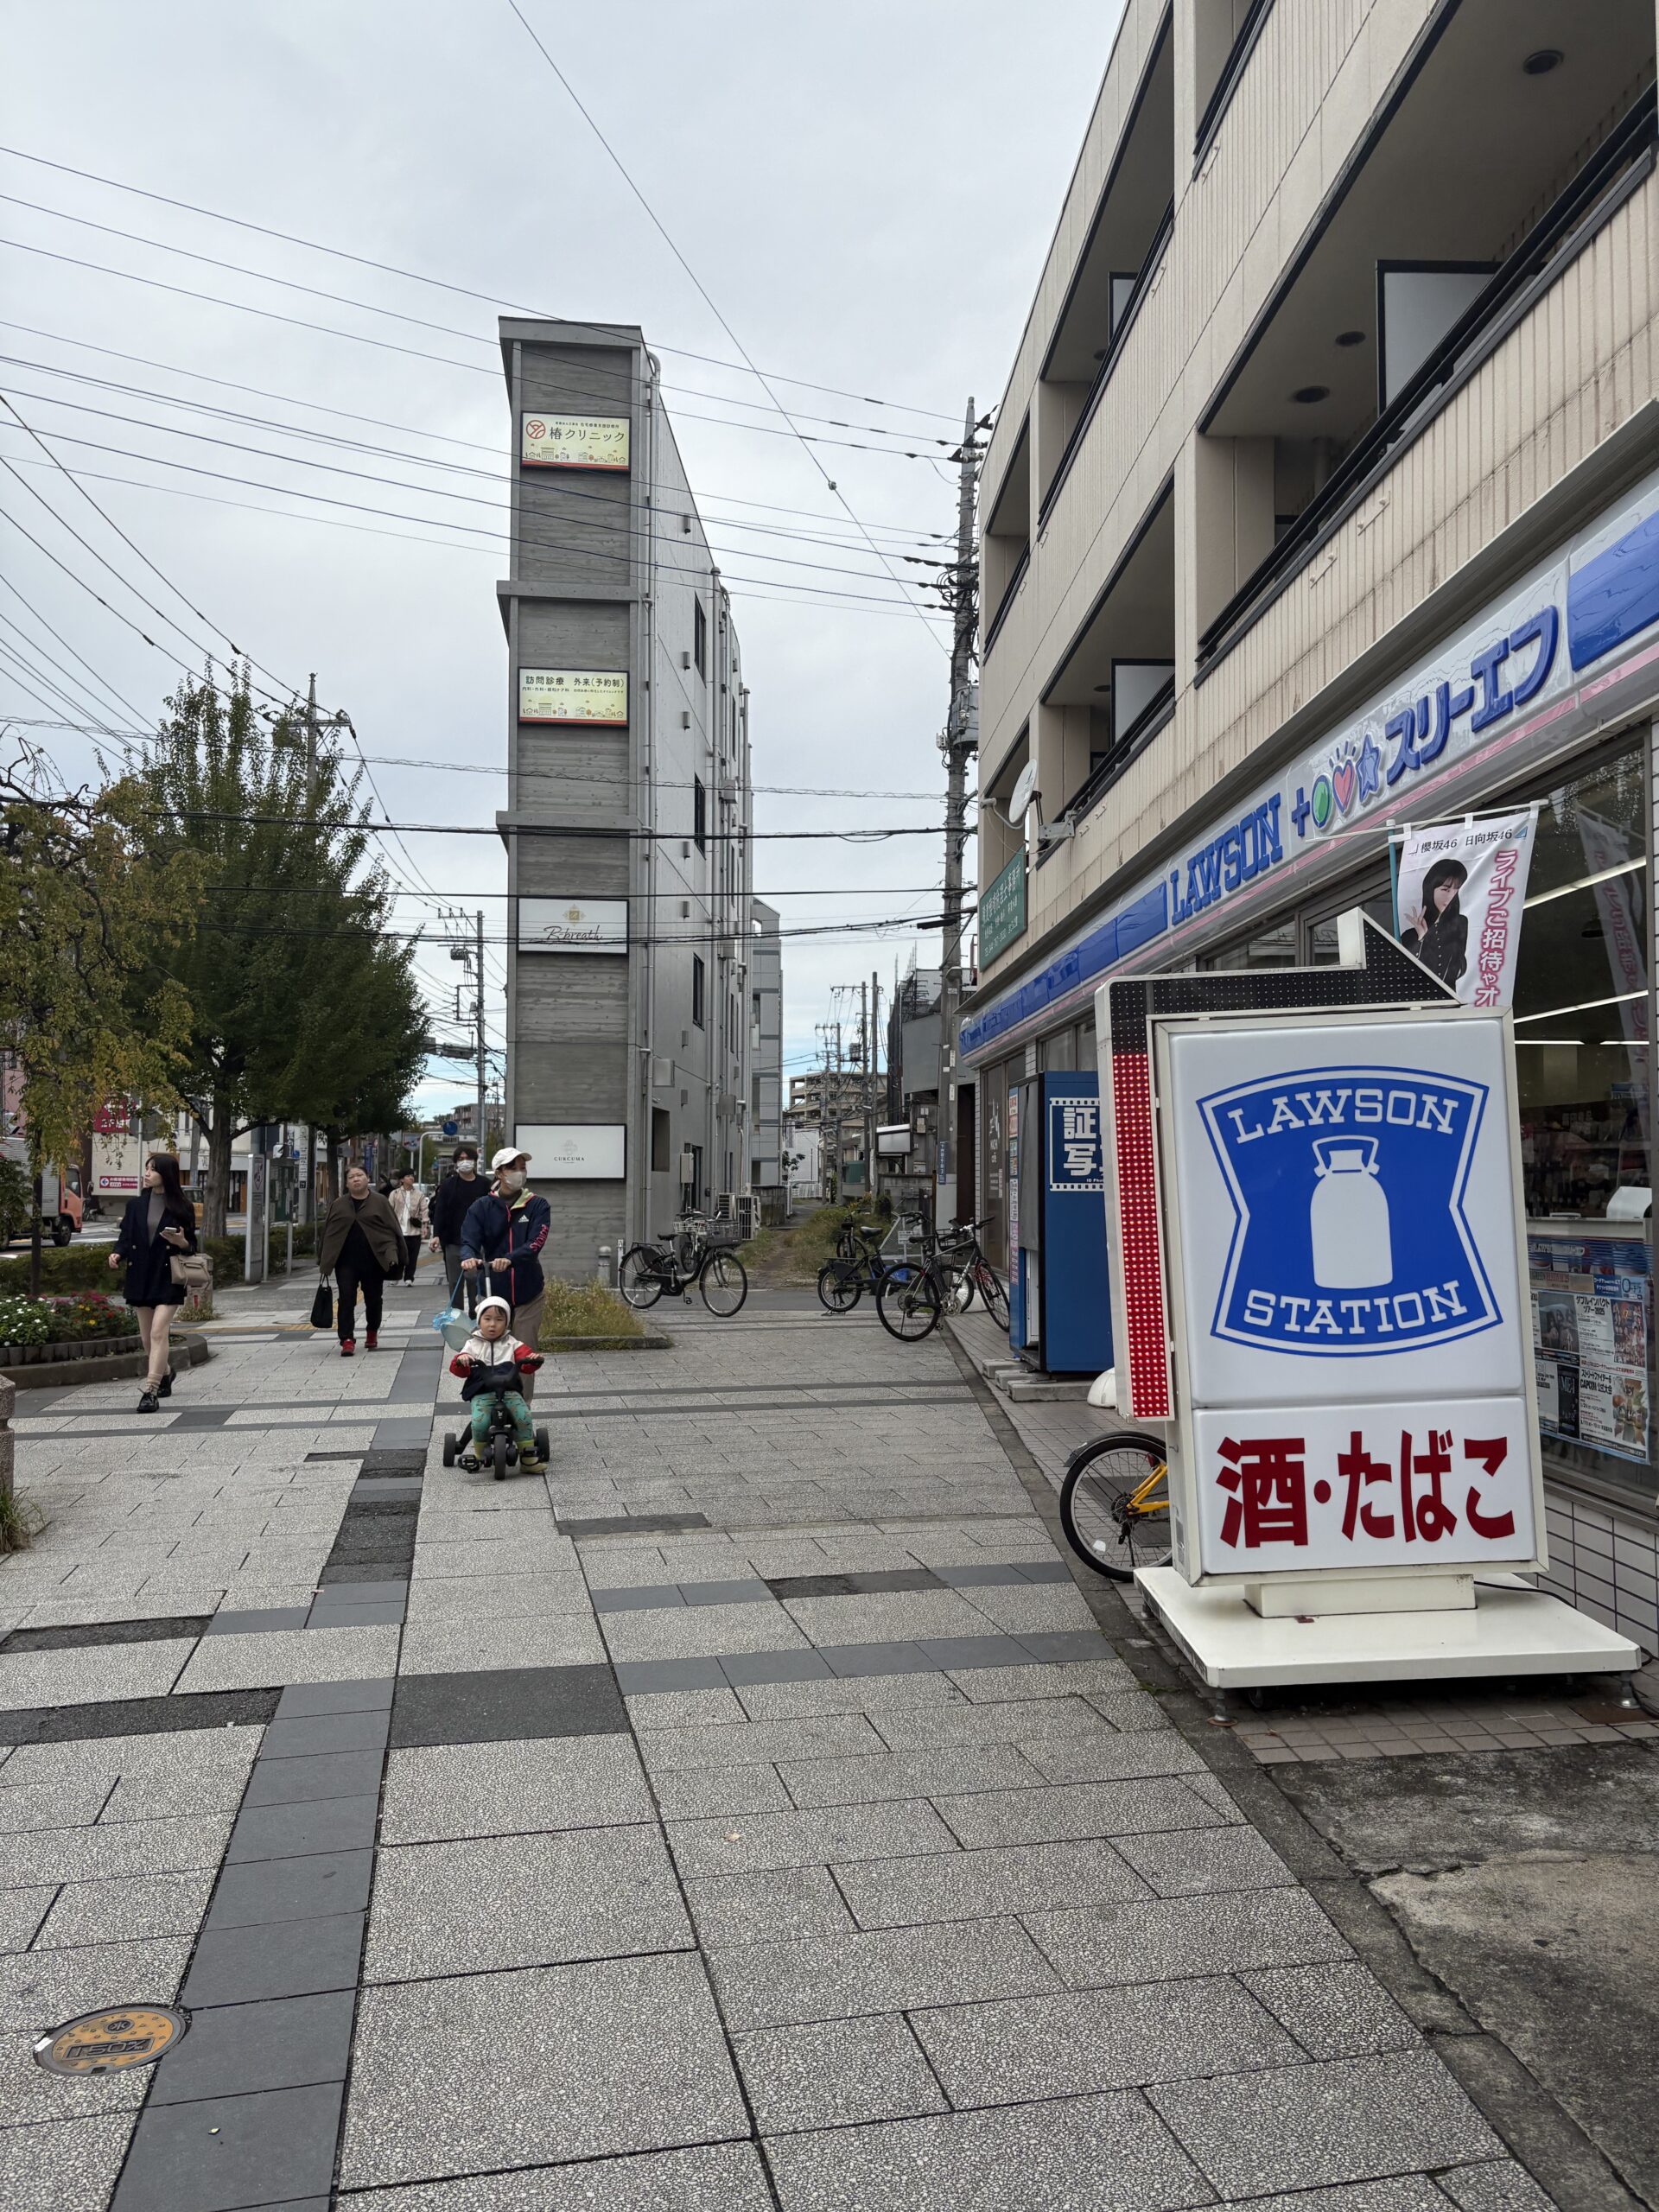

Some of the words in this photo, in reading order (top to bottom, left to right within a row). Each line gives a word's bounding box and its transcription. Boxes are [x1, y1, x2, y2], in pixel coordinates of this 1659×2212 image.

[549, 426, 625, 442] 椿クリニック
[525, 676, 564, 685] 訪問診療
[1385, 604, 1559, 785] スリーエフ
[1421, 839, 1458, 854] 櫻坂46
[1465, 829, 1512, 847] 日向坂46
[1170, 792, 1284, 926] LAWSON
[1063, 1107, 1096, 1139] 証
[1227, 1088, 1459, 1144] LAWSON
[1063, 1143, 1103, 1176] 写
[1243, 1280, 1468, 1335] STATION
[1576, 1296, 1611, 1307] ダブルインパクト
[1216, 1429, 1516, 1549] 酒・たばこ
